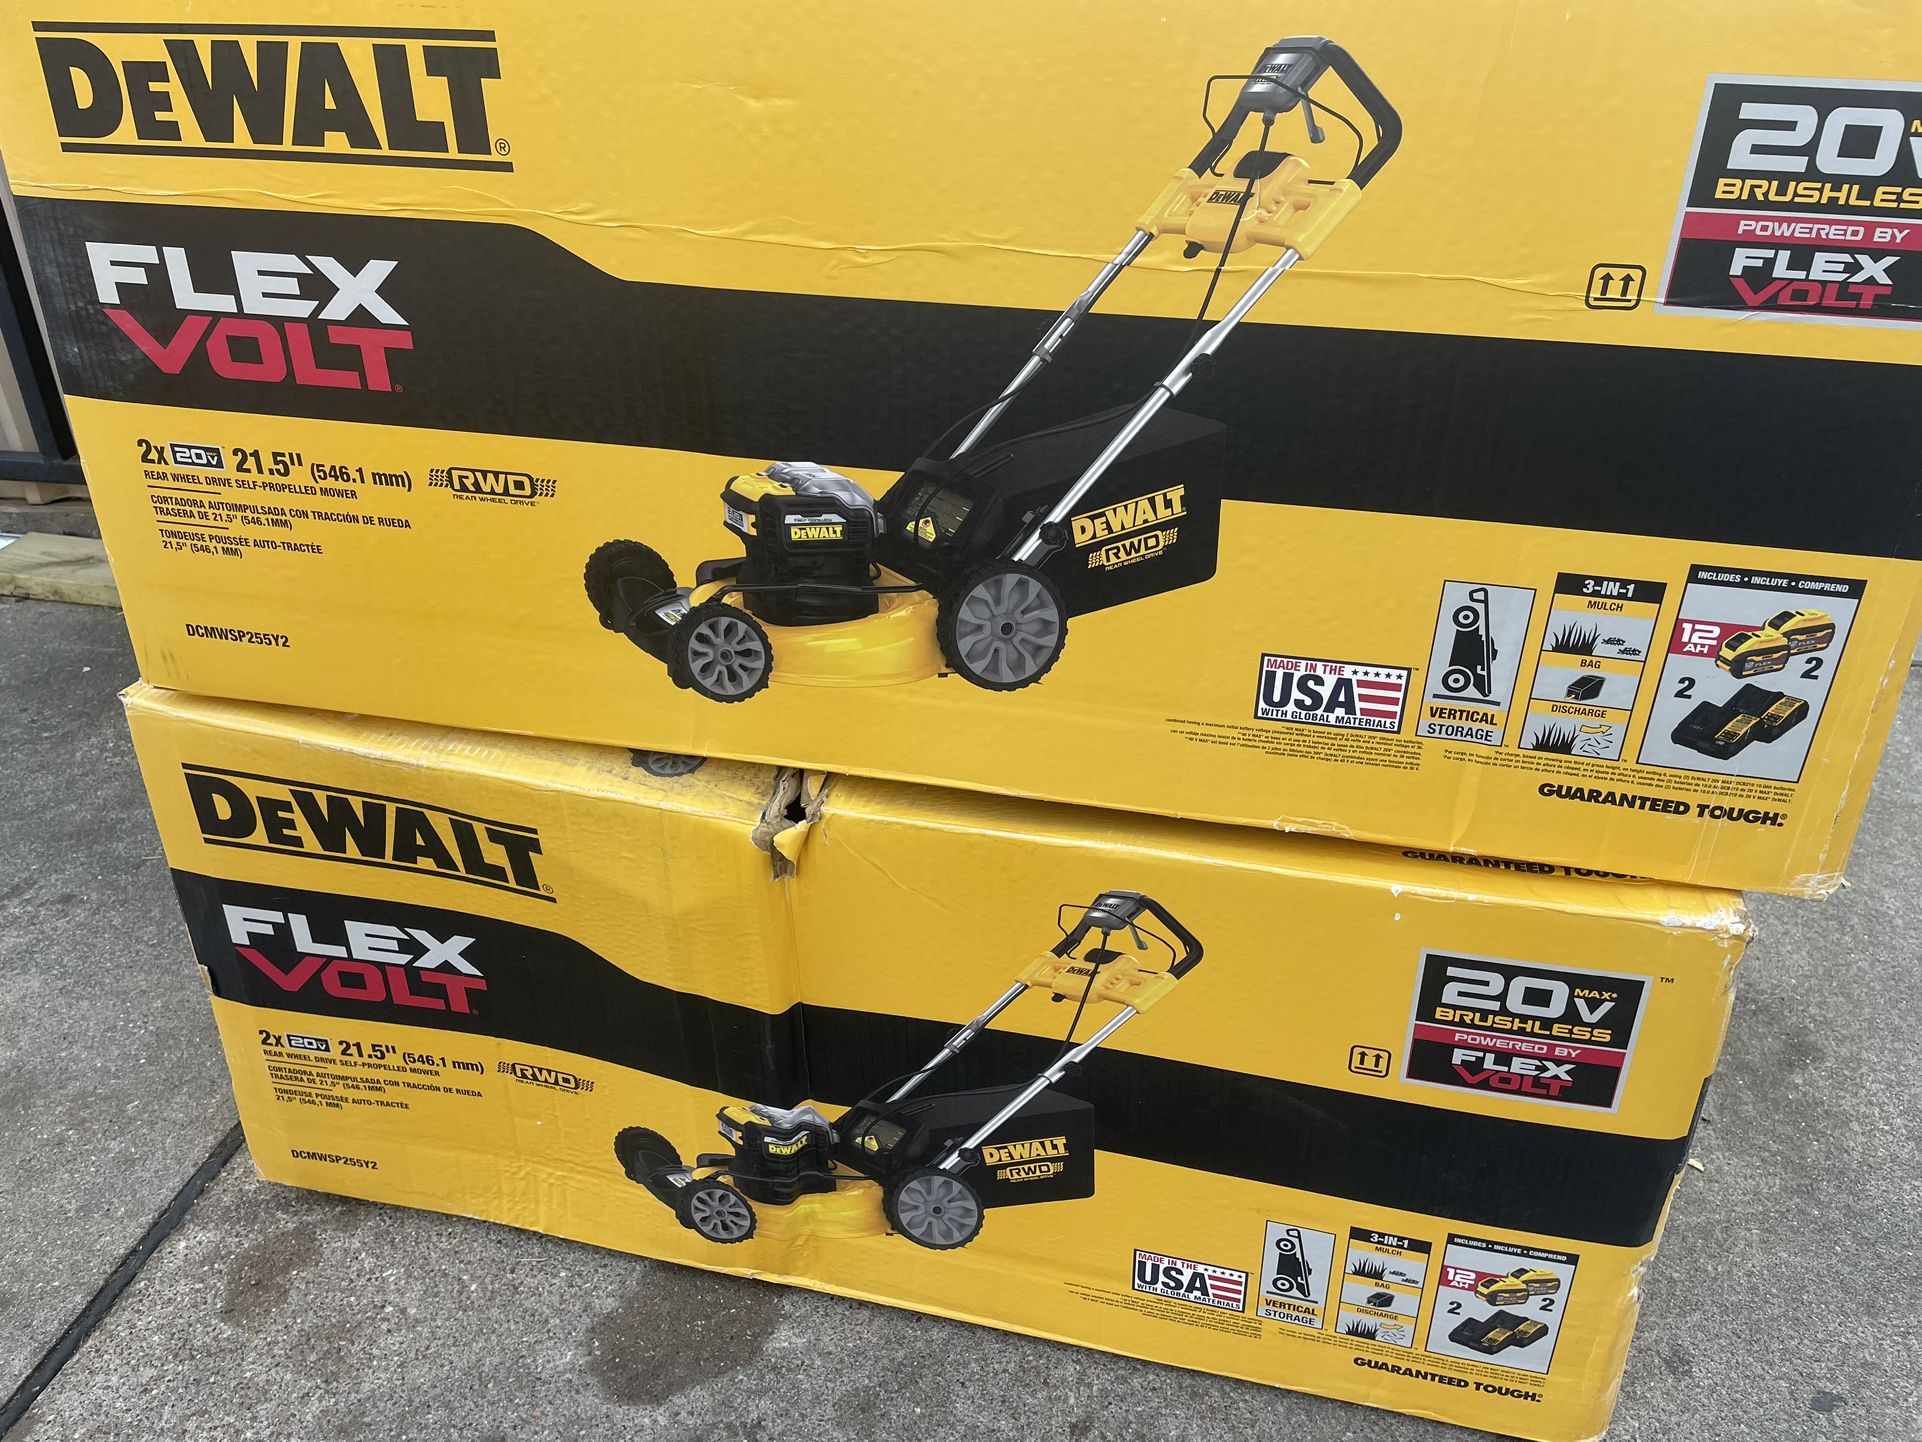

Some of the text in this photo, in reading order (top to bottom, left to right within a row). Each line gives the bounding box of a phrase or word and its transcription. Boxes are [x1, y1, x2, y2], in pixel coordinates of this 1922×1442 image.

[1737, 220, 1911, 244] POWERED BY
[1729, 248, 1901, 285] FLEX
[85, 240, 411, 327] FLEX
[1728, 276, 1893, 309] VOLT
[102, 307, 414, 393] VOLT
[137, 439, 169, 465] 2x
[232, 448, 303, 477] 21.5"
[311, 463, 366, 484] (546.1
[372, 470, 412, 492] mm)
[144, 470, 358, 499] REAR WHEEL DRIVE SELF-PROPELLED MOWER
[451, 469, 533, 497] RWD
[150, 494, 412, 529] CORTADORA AUTOIMPULSADA CON TRACCIÓN DE RUEDA
[452, 493, 536, 507] REAR WHEEL DRIVE
[153, 506, 293, 530] TRASERA DE 21.5" (546.1MM)
[159, 529, 323, 554] TONDEUSE POUSSÉE AUTO-TRACTÉE
[222, 548, 243, 559] MM)
[1105, 534, 1160, 562] RWD
[1105, 551, 1163, 571] REAR WHEEL DRIVE
[1582, 579, 1636, 598] 3-IN-1
[1698, 570, 1850, 593] INCLUDES INCLUYE COMPREND
[1587, 600, 1624, 612] MULCH
[185, 623, 291, 647] DCMWSP255Y2
[1681, 622, 1721, 646] 12
[1683, 645, 1709, 654] AH
[1266, 658, 1345, 676] MADE IN THE
[1580, 659, 1601, 670] BAG
[1800, 656, 1824, 680] 2
[1262, 669, 1357, 716] USA
[1674, 676, 1696, 699] 2
[1261, 707, 1396, 730] WITH GLOBAL MATERIALS
[1429, 706, 1498, 726] VERTICAL
[1551, 704, 1607, 719] DISCHARGE
[1427, 723, 1494, 742] STORAGE
[1538, 782, 1690, 816] GUARANTEED
[1402, 850, 1555, 875] GUARANTEED
[222, 903, 484, 977] FLEX
[233, 945, 488, 1015] VOLT
[1441, 966, 1616, 1024] 20V
[1434, 1007, 1612, 1043] BRUSHLESS
[258, 1029, 285, 1048] 2x
[402, 1051, 447, 1068] (546.1
[451, 1060, 485, 1075] mm)
[1455, 1033, 1581, 1058] POWERED BY
[263, 1049, 440, 1077] REAR WHEEL DRIVE SELF-PROPELLED MOWER
[1451, 1048, 1576, 1081] FLEX
[267, 1065, 314, 1077] CORTADORA
[316, 1071, 381, 1085] AUTOIMPULSADA
[383, 1079, 400, 1087] CON
[455, 1088, 483, 1098] RUEDA
[270, 1073, 305, 1083] TRASERA
[307, 1077, 318, 1085] DE
[515, 1064, 576, 1088] RWD
[1452, 1064, 1573, 1097] VOLT
[273, 1087, 314, 1099] TONDEUSE
[291, 1149, 379, 1170] DCMWSP255Y2
[1009, 1164, 1051, 1178] RWD
[1370, 1233, 1409, 1248] 3-IN-1
[1375, 1246, 1402, 1256] MULCH
[1454, 1237, 1567, 1261] INCLUDES INCLUYE COMPREND
[1138, 1253, 1165, 1264] MADE
[1181, 1262, 1198, 1271] THE
[1137, 1260, 1210, 1297] USA
[1374, 1282, 1390, 1290] BAG
[1446, 1267, 1476, 1284] 12
[1450, 1280, 1469, 1289] AH
[1136, 1282, 1240, 1309] WITH GLOBAL MATERIALS
[1264, 1298, 1318, 1316] VERTICAL
[1539, 1298, 1555, 1312] 2
[1264, 1309, 1315, 1326] STORAGE
[1356, 1307, 1399, 1321] DISCHARGE
[1447, 1301, 1463, 1315] 2
[1353, 1356, 1469, 1388] GUARANTEED
